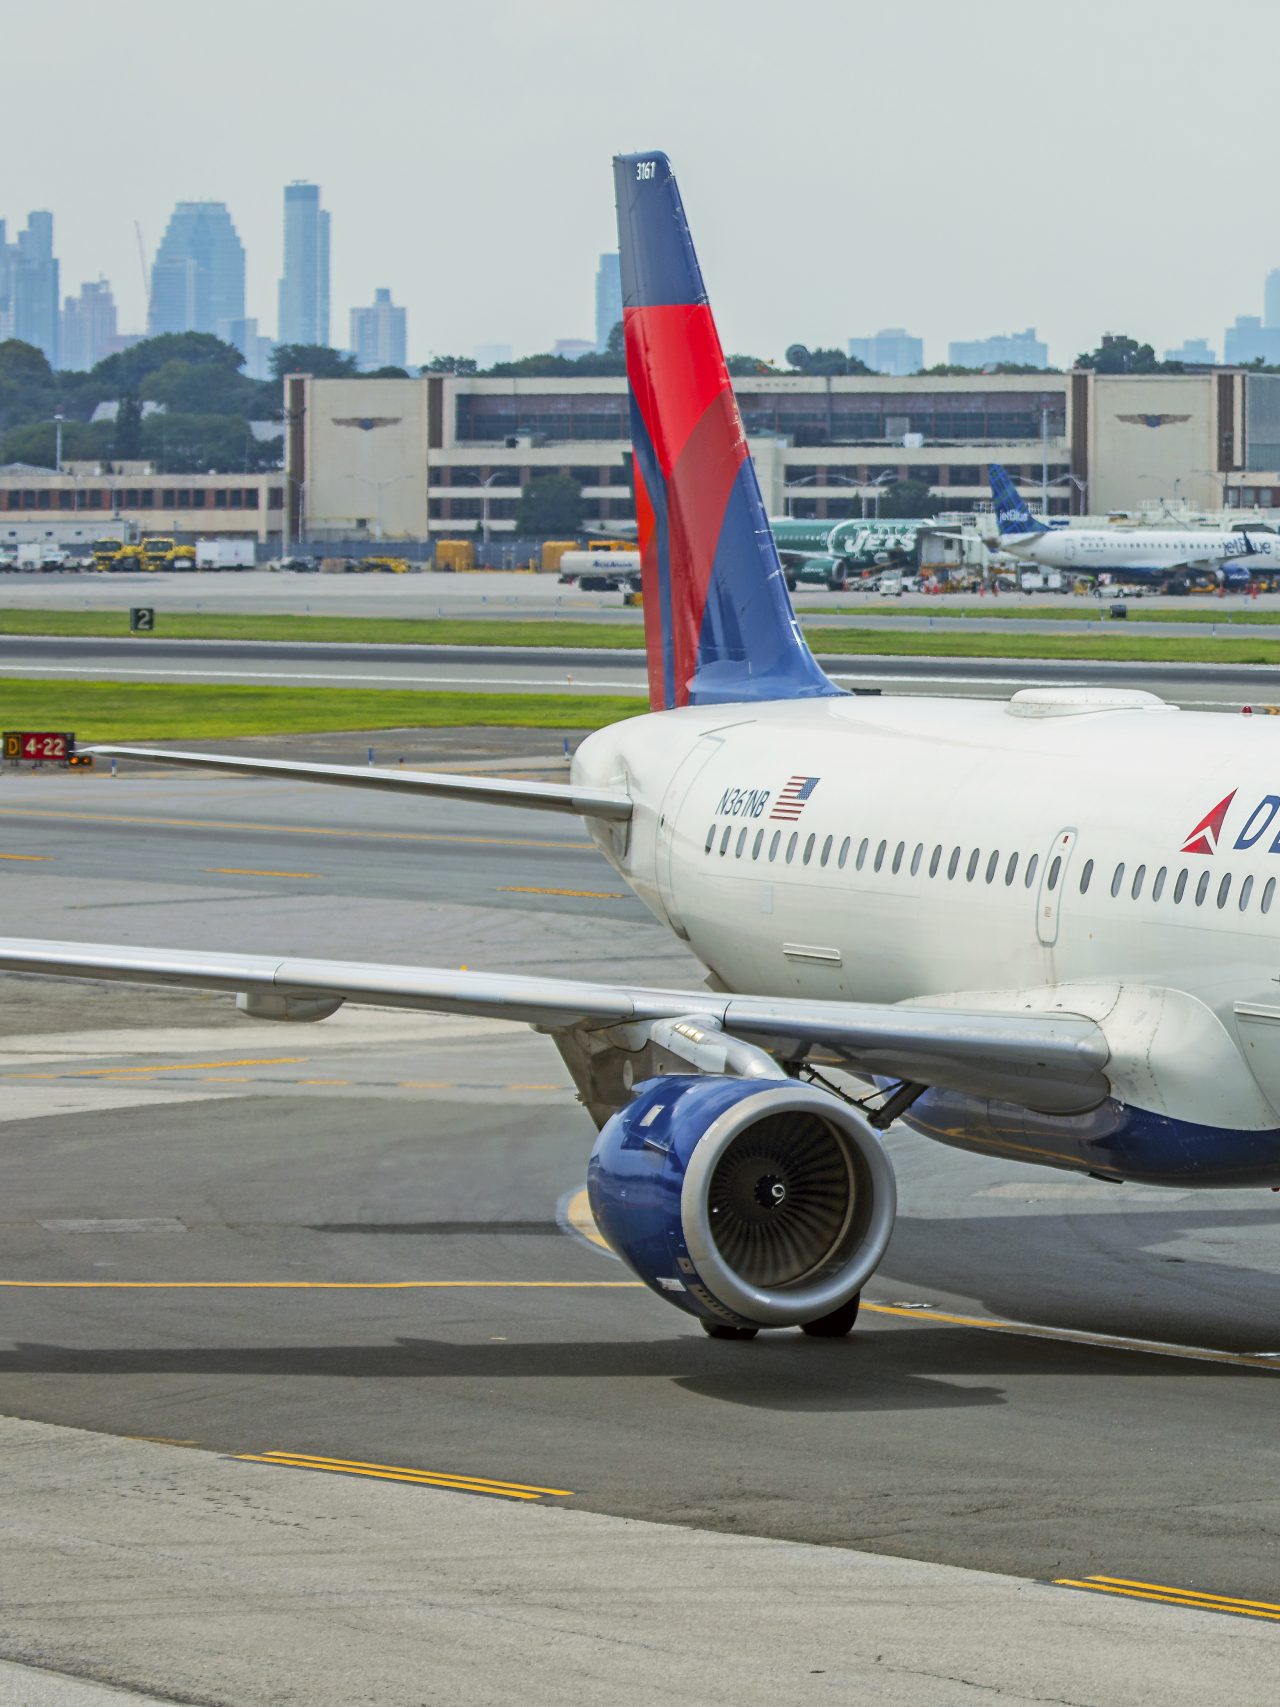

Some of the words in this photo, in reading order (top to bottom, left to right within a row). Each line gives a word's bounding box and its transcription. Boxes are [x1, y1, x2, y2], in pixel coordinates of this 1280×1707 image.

[636, 161, 656, 180] 3161
[137, 609, 150, 629] 2
[8, 738, 18, 754] D
[25, 738, 64, 756] 4-22
[714, 787, 771, 818] N361NB
